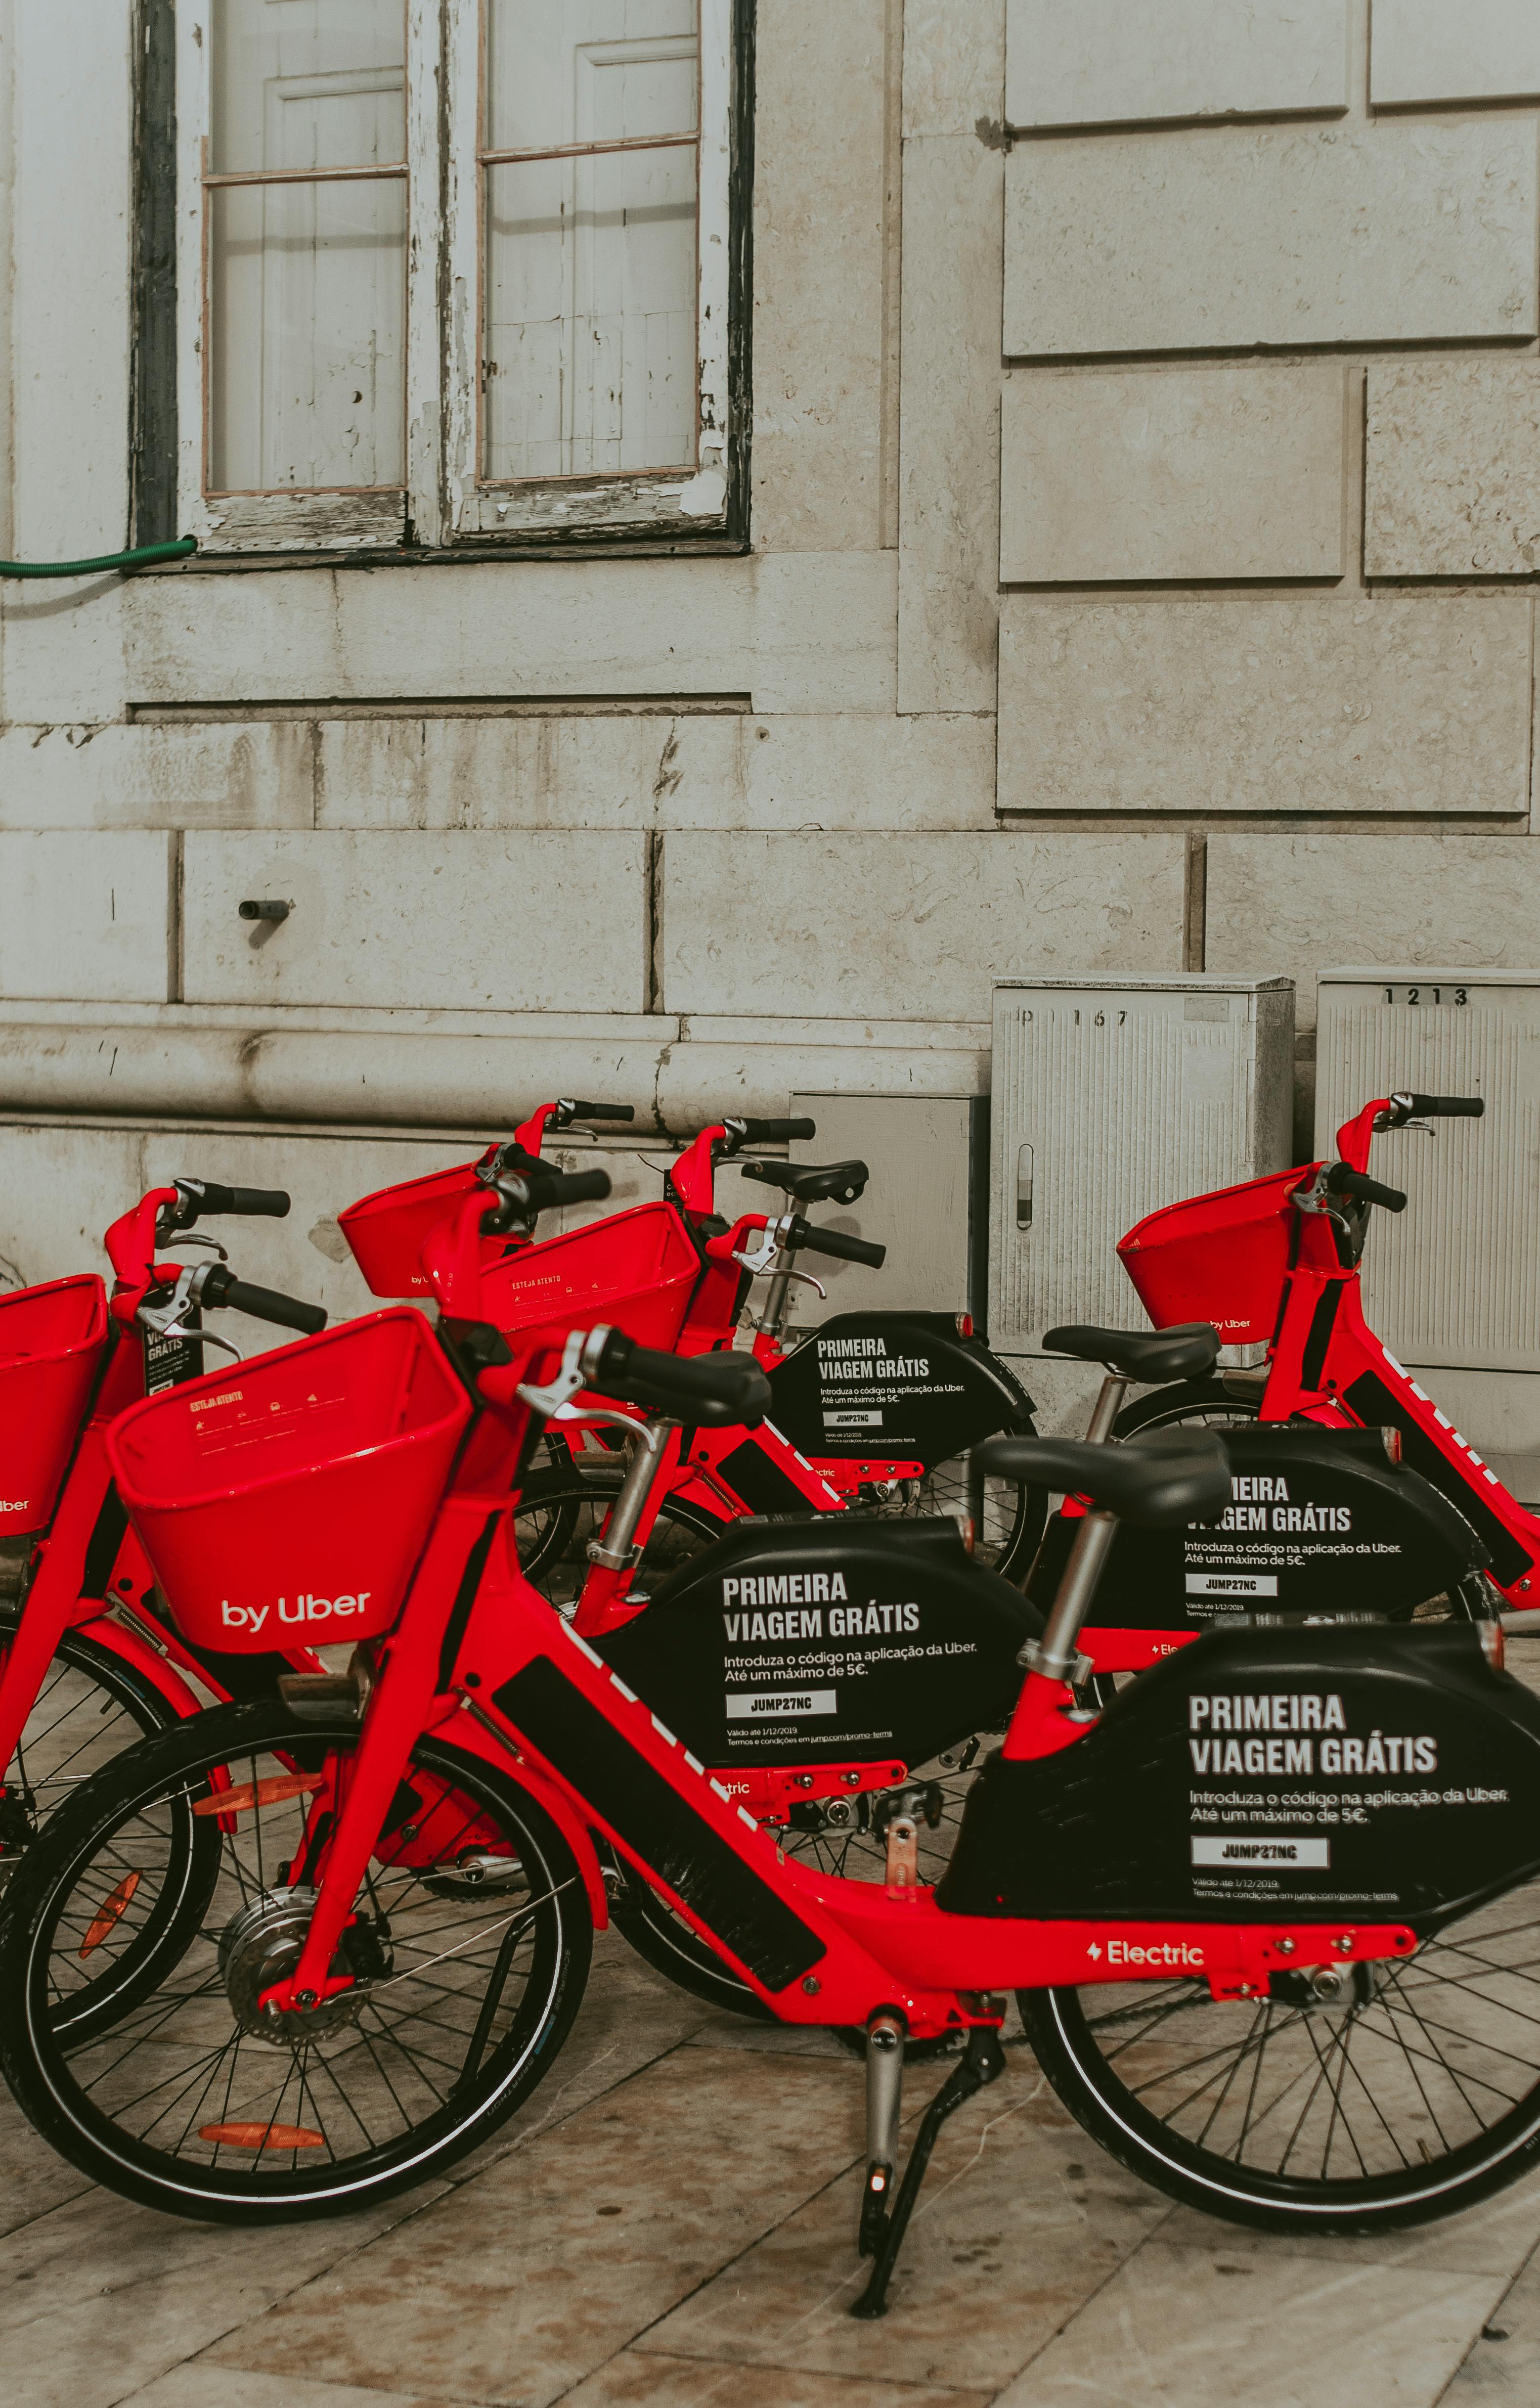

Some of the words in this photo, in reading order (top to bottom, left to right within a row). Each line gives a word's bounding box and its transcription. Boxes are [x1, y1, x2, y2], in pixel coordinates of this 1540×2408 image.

[1385, 988, 1467, 1006] 1213
[412, 1276, 422, 1284] by
[512, 1280, 536, 1289] ESTEJA
[537, 1275, 561, 1285] ATENTO
[1210, 1320, 1223, 1330] by
[1224, 1320, 1250, 1328] Uber
[817, 1338, 886, 1358] PRIMEIRA
[819, 1361, 873, 1379] VIAGEM
[876, 1356, 929, 1377] GRÁTIS
[216, 1391, 243, 1405] ATENTO
[860, 1387, 886, 1395] código
[897, 1385, 932, 1395] aplicação
[1231, 1477, 1289, 1501] EIRA
[1187, 1507, 1267, 1531] GEM
[1272, 1502, 1351, 1531] GRÁTIS
[1185, 1541, 1234, 1552] Introduza
[1246, 1543, 1285, 1554] código
[1302, 1544, 1354, 1555] aplicação
[1356, 1544, 1371, 1553] da
[1373, 1543, 1401, 1553] Uber.
[1185, 1553, 1204, 1563] Até
[1225, 1554, 1268, 1565] máximo
[1270, 1555, 1285, 1565] de
[1287, 1555, 1305, 1565] 5€.
[723, 1573, 848, 1606] PRIMEIRA
[1206, 1579, 1256, 1590] JUMP27NC
[222, 1600, 269, 1633] by
[278, 1592, 371, 1624] Uber
[724, 1610, 822, 1641] VIAGEM
[829, 1598, 919, 1636] GRÁTIS
[725, 1655, 784, 1667] Introduza
[787, 1656, 795, 1665] o
[799, 1652, 844, 1665] código
[847, 1653, 862, 1661] na
[864, 1646, 923, 1662] aplicação
[926, 1644, 943, 1655] da
[945, 1642, 977, 1654] Uber.
[725, 1670, 747, 1681] Até
[751, 1671, 770, 1680] um
[773, 1667, 824, 1679] máximo
[827, 1665, 844, 1677] de
[847, 1664, 868, 1675] 5€.
[751, 1697, 811, 1712] JUMP27NC
[1190, 1695, 1346, 1731] PRIMEIRA
[811, 1731, 892, 1743] jump.com/promo-terms
[1190, 1739, 1313, 1775] VIAGEM
[1319, 1729, 1437, 1774] GRÁTIS
[724, 1781, 750, 1795] tric
[1190, 1791, 1264, 1806] Introduza
[1267, 1795, 1279, 1806] o
[1281, 1792, 1339, 1807] código
[1342, 1794, 1362, 1805] na
[1364, 1790, 1440, 1808] aplicação
[1442, 1789, 1465, 1803] da
[1467, 1788, 1507, 1803] Uber.
[1191, 1807, 1219, 1821] Até
[1222, 1811, 1247, 1822] um
[1250, 1808, 1314, 1823] máximo
[1316, 1808, 1339, 1823] de
[1342, 1808, 1368, 1823] 5€.
[1222, 1845, 1297, 1859] JUMP27NC
[1192, 1878, 1218, 1886] Válido
[1193, 1889, 1224, 1897] Termos
[1233, 1892, 1279, 1900] condições
[1295, 1893, 1399, 1901] jump.com/promo-terms
[1107, 1940, 1204, 1967] Electric
[553, 1948, 570, 2011] SCHWALBE
